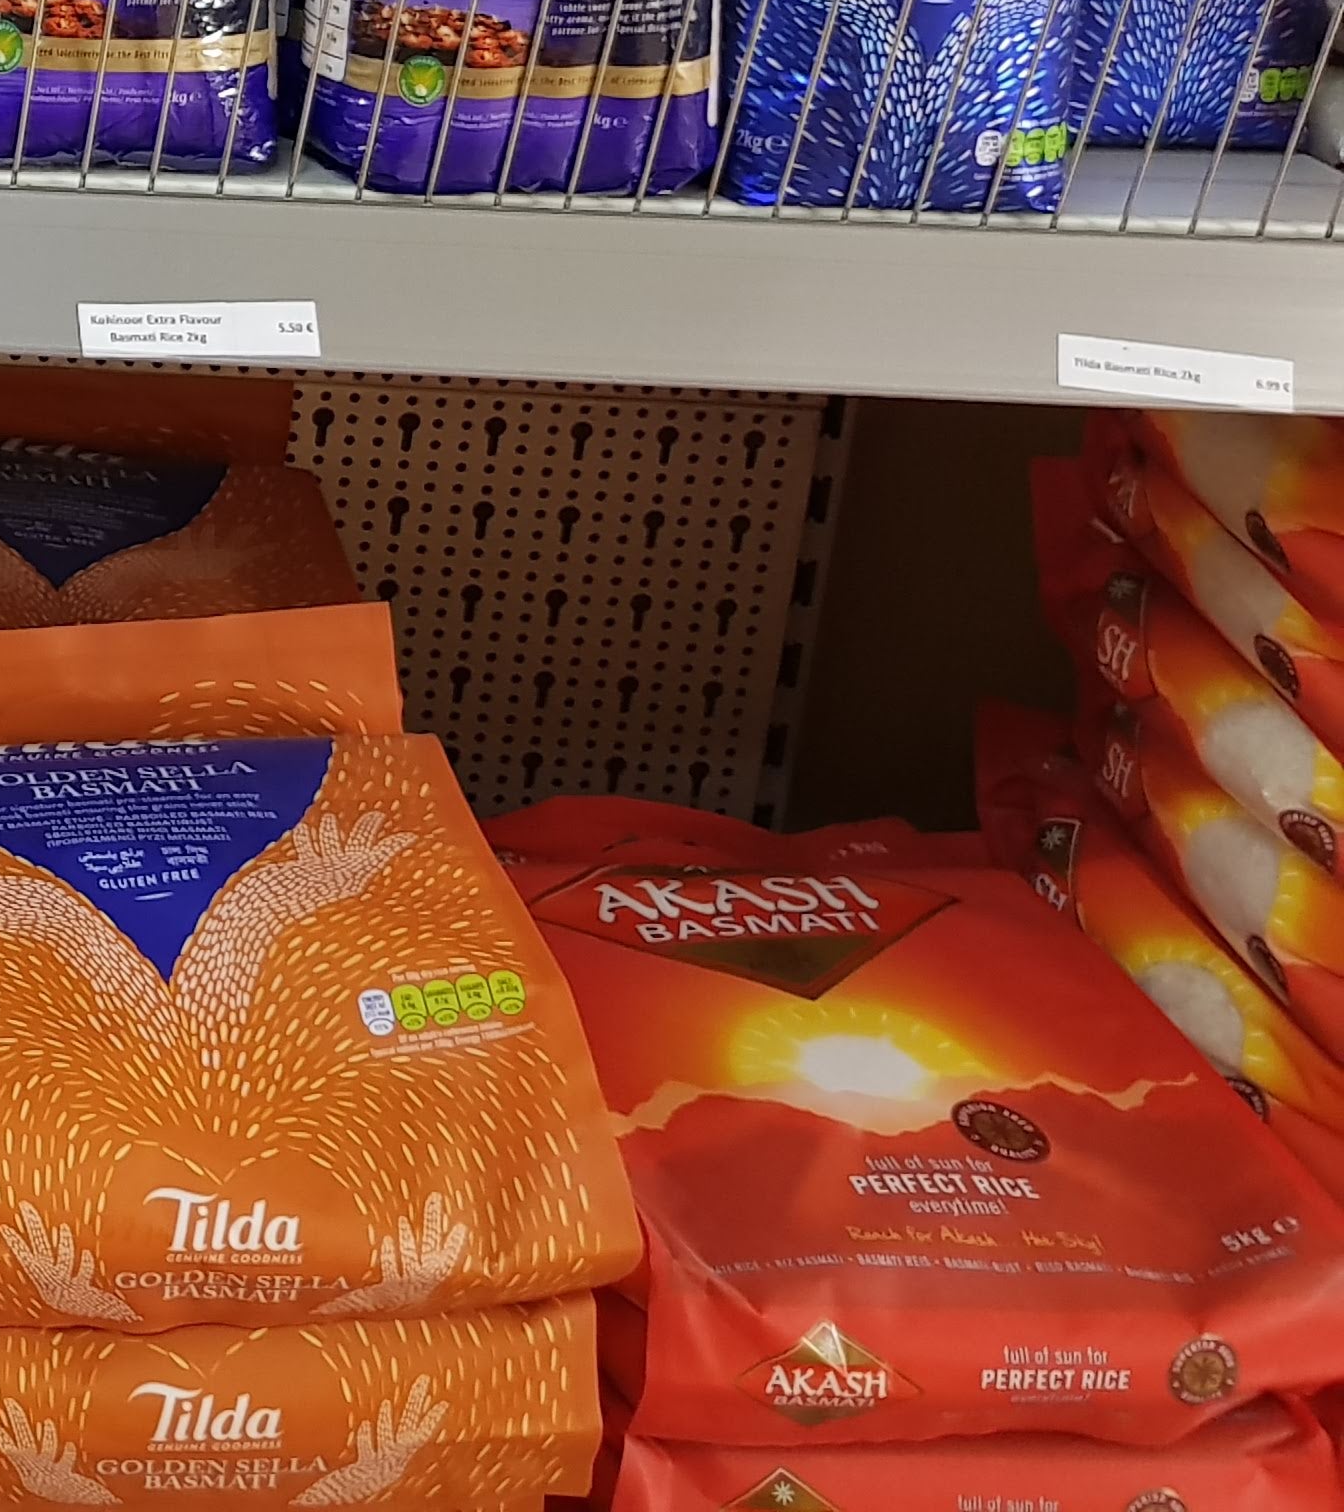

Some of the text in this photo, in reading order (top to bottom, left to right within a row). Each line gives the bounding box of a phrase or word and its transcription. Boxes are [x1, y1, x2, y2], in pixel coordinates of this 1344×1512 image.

[147, 315, 176, 324] Extra
[179, 315, 222, 324] Flavour
[278, 322, 302, 332] 5.50
[110, 333, 207, 344] Basmati Rice 2kg
[1181, 370, 1201, 383] 2kg
[137, 761, 256, 780] SELLA
[31, 778, 202, 800] BASMATI
[99, 868, 200, 889] GLUTEN FREE
[595, 874, 880, 925] AKASH
[637, 911, 880, 945] BASMATI
[849, 1174, 1040, 1200] PERFECT RICE
[143, 1186, 303, 1254] Tilda
[115, 1270, 350, 1290] GOLDEN SELLA
[765, 1365, 888, 1399] AKASH
[981, 1369, 1131, 1390] PERFECT RICE
[128, 1381, 283, 1443] Tilda
[96, 1457, 327, 1476] GOLDEN SELLA
